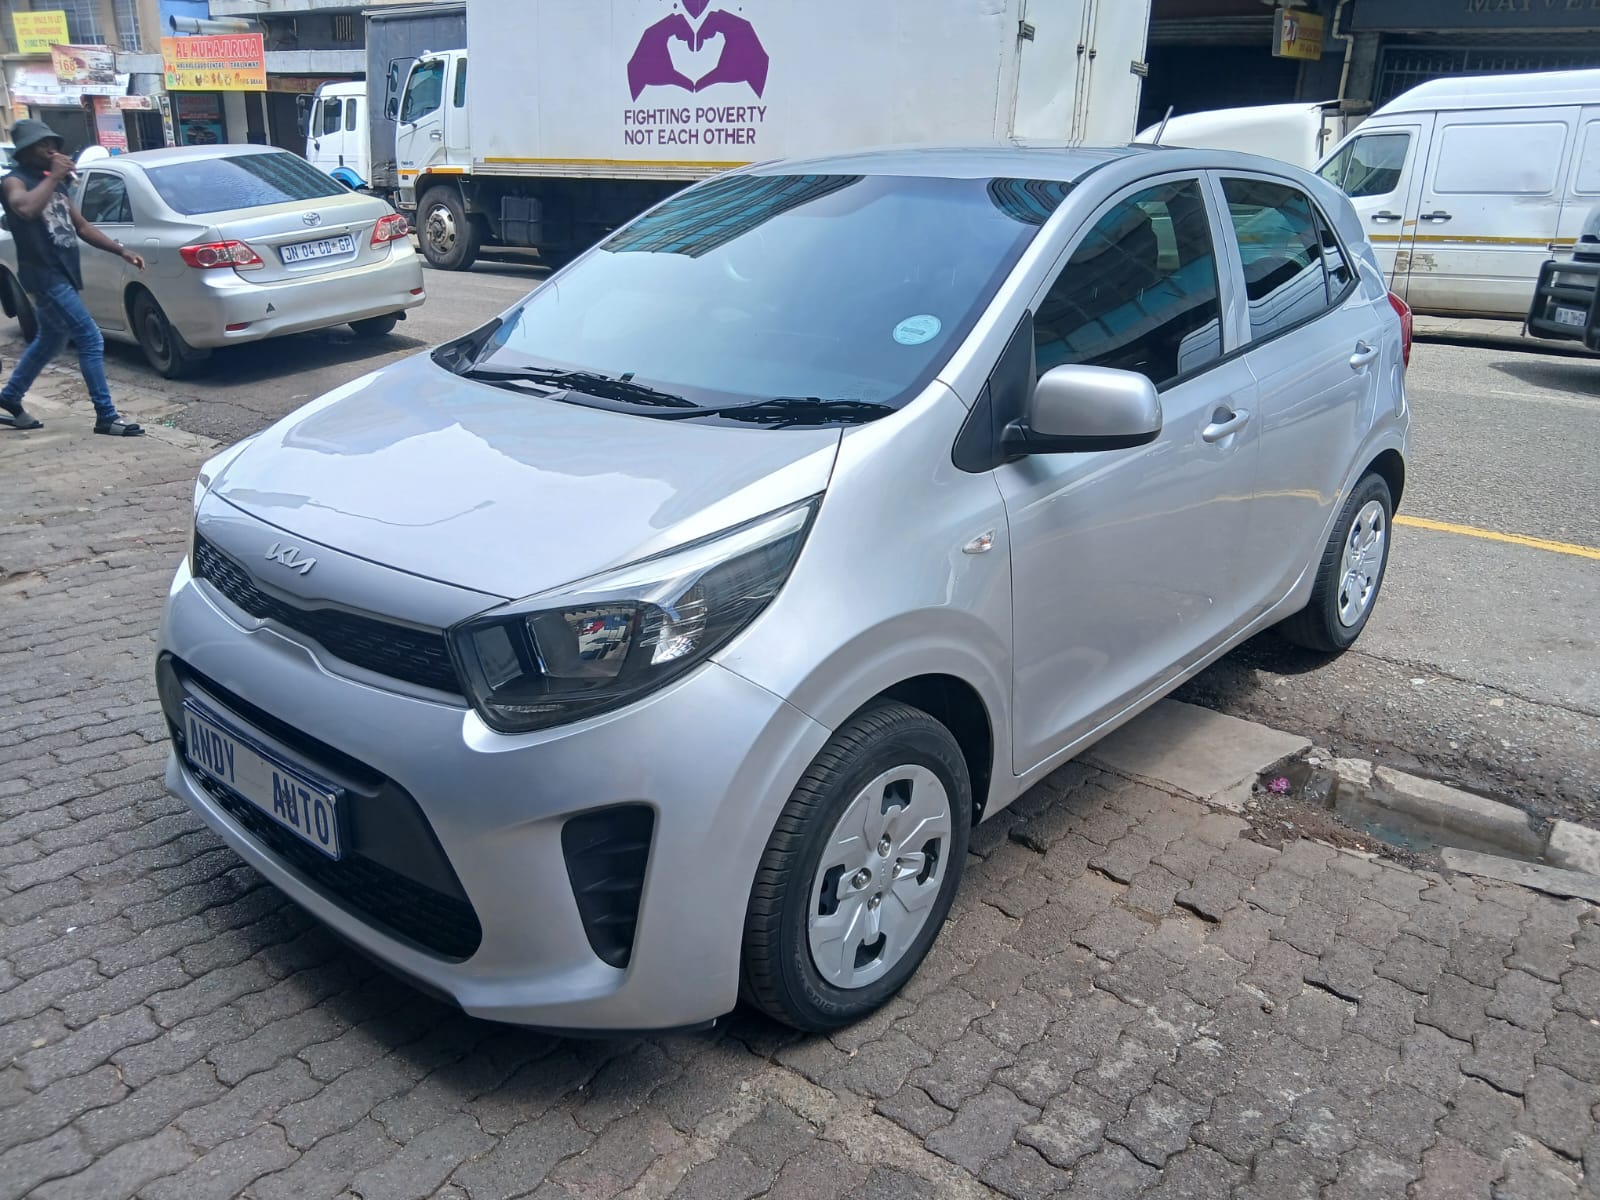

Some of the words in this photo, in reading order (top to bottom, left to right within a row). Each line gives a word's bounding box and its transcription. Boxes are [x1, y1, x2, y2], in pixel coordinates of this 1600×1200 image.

[176, 43, 188, 58] AL
[624, 108, 691, 125] FIGHTING
[695, 106, 767, 124] POVERTY
[624, 130, 653, 145] NOT
[658, 129, 699, 145] EACH
[703, 128, 756, 145] OTHER
[285, 245, 299, 261] JN
[302, 244, 315, 258] 04
[319, 240, 332, 255] CD
[339, 237, 351, 251] GP
[264, 541, 317, 576] KIA
[190, 717, 235, 784] ANDY
[272, 770, 329, 846] AUTO
